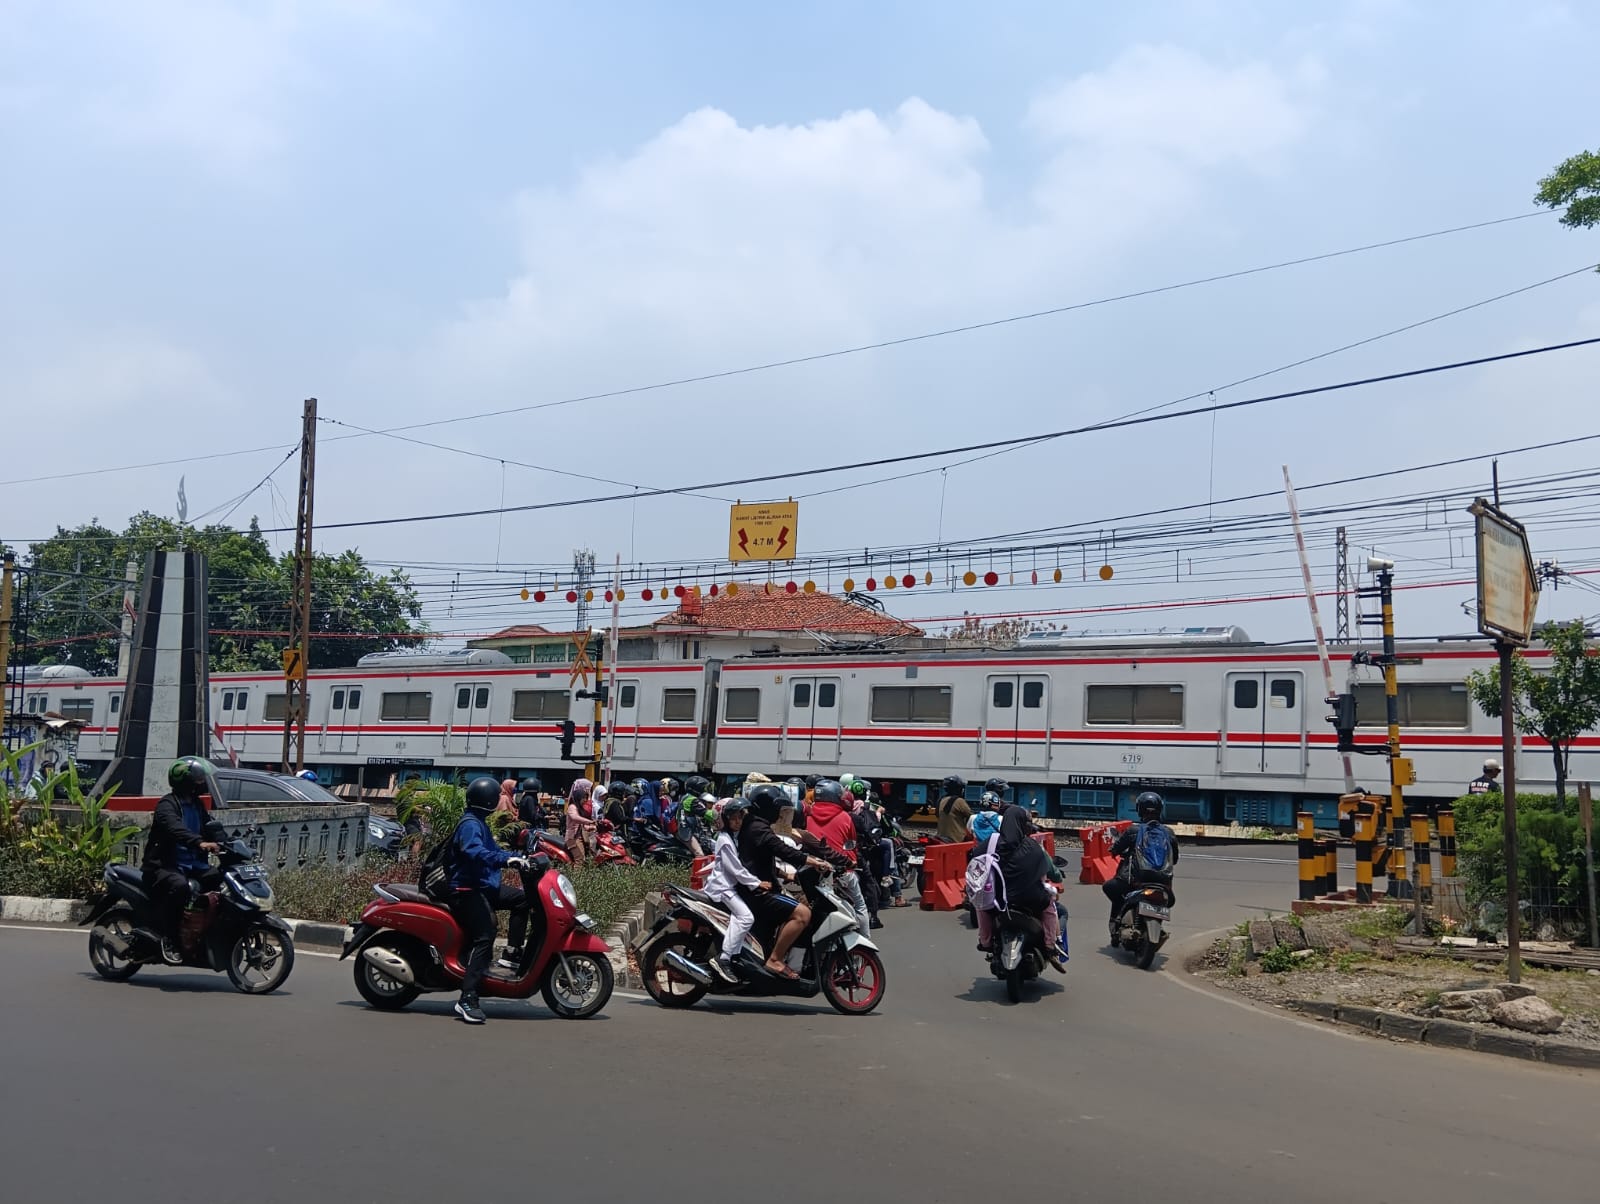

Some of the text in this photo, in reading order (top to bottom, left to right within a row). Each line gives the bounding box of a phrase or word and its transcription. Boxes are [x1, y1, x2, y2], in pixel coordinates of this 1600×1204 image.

[752, 537, 774, 546] 4.7 M
[1122, 754, 1142, 762] 6719
